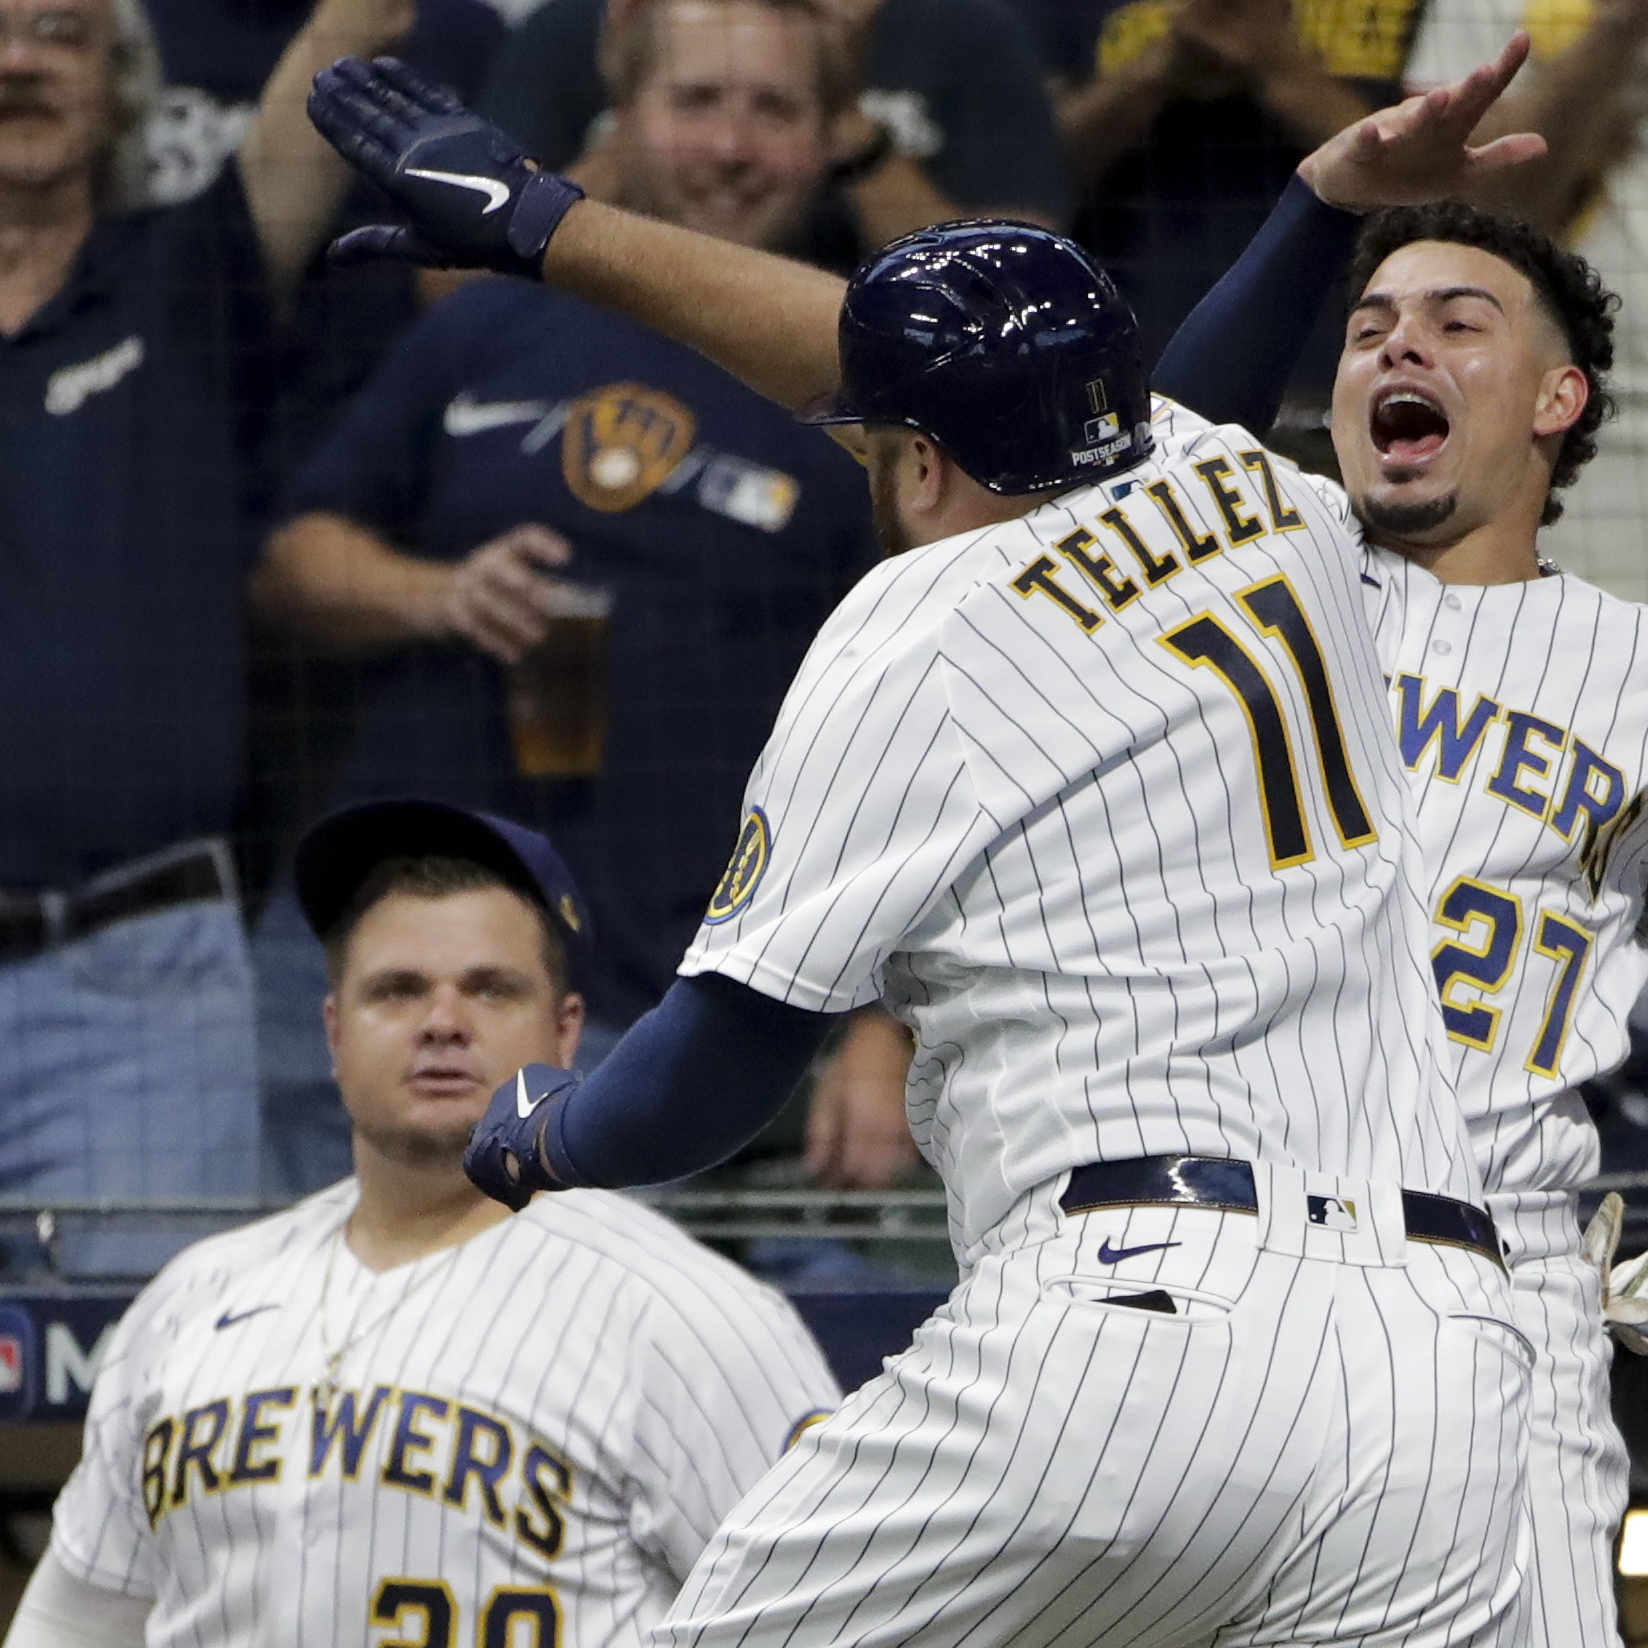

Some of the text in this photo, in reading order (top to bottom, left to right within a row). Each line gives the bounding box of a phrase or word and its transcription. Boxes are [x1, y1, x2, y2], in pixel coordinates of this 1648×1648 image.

[1008, 448, 1307, 636] TELLEZ
[1071, 433, 1132, 467] POSTSEASON
[1155, 571, 1379, 871] 11
[1429, 874, 1596, 1080] 27
[141, 1384, 573, 1563] BREWERS
